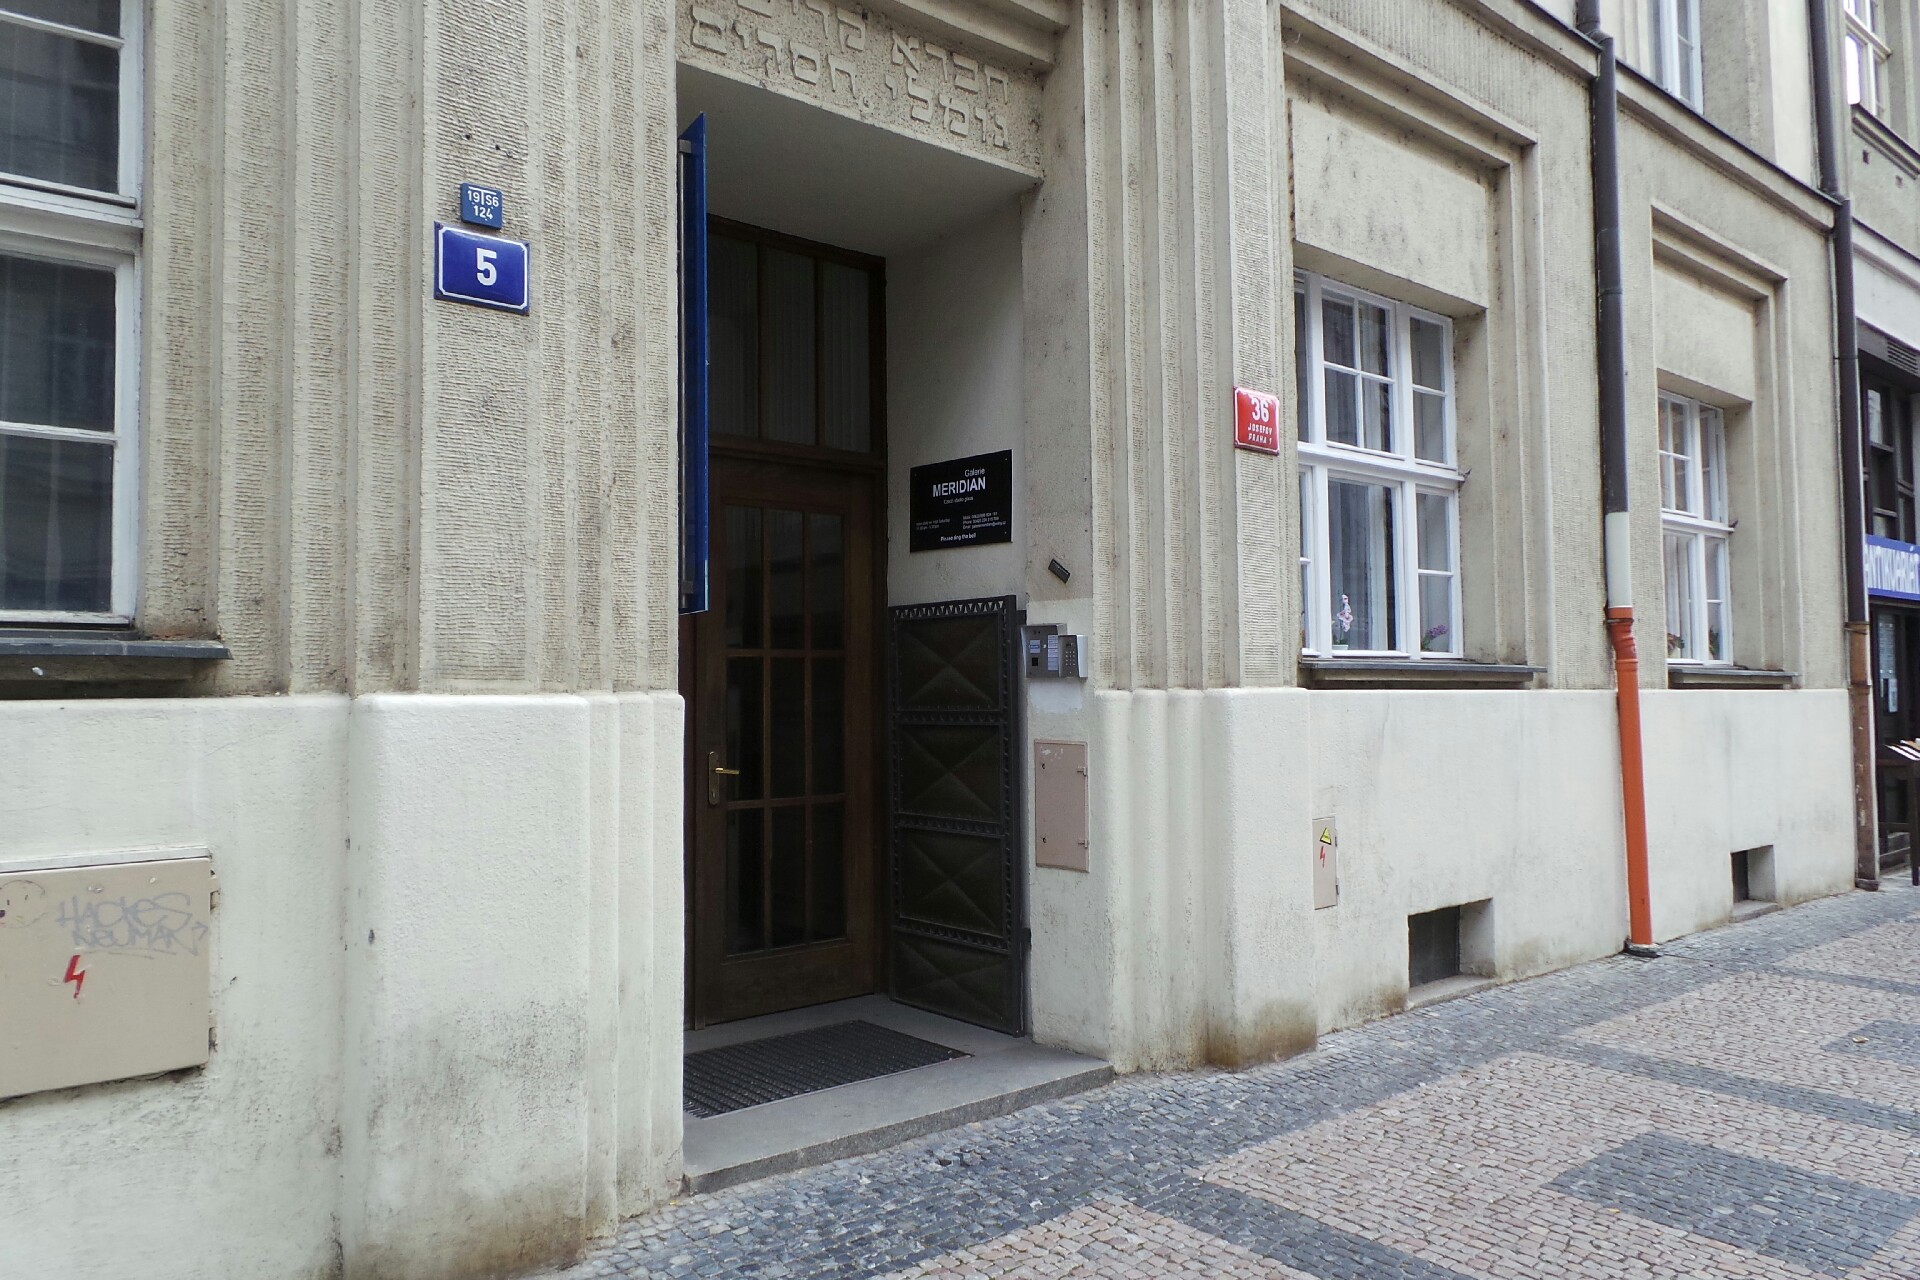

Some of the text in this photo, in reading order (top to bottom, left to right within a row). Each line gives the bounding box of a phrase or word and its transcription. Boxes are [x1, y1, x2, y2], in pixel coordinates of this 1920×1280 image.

[690, 5, 858, 99] חסדים
[473, 205, 494, 220] 124
[476, 247, 498, 286] 5
[1251, 397, 1270, 423] 36
[1247, 422, 1273, 436] JOSEFOV
[1247, 433, 1268, 444] PRAHA
[964, 467, 986, 478] Galerie
[932, 476, 986, 498] MERIDIAN
